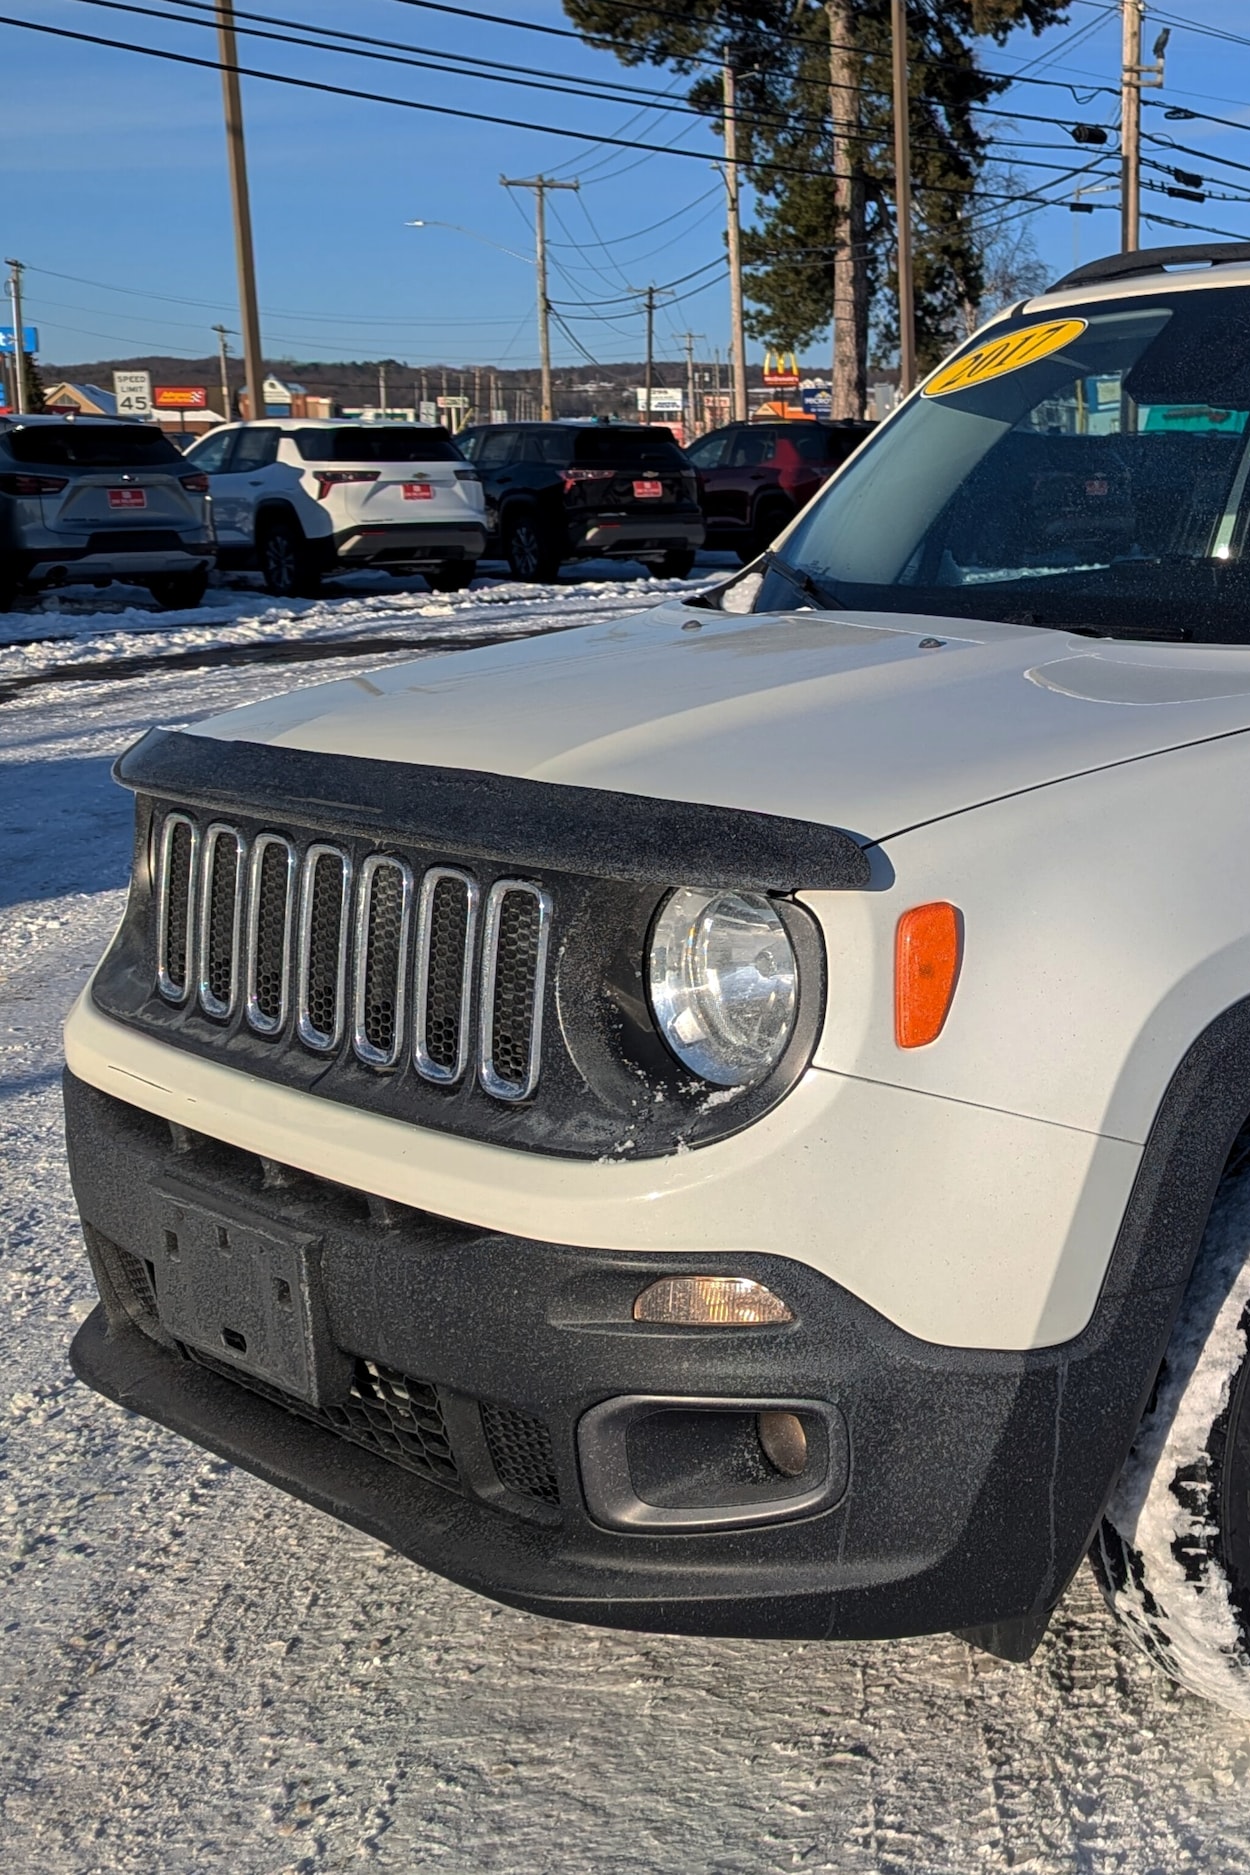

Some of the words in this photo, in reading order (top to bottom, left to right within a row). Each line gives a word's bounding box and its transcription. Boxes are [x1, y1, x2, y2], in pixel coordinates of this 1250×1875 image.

[937, 322, 1070, 391] 2017
[117, 375, 147, 383] SPEED
[119, 396, 147, 410] 45
